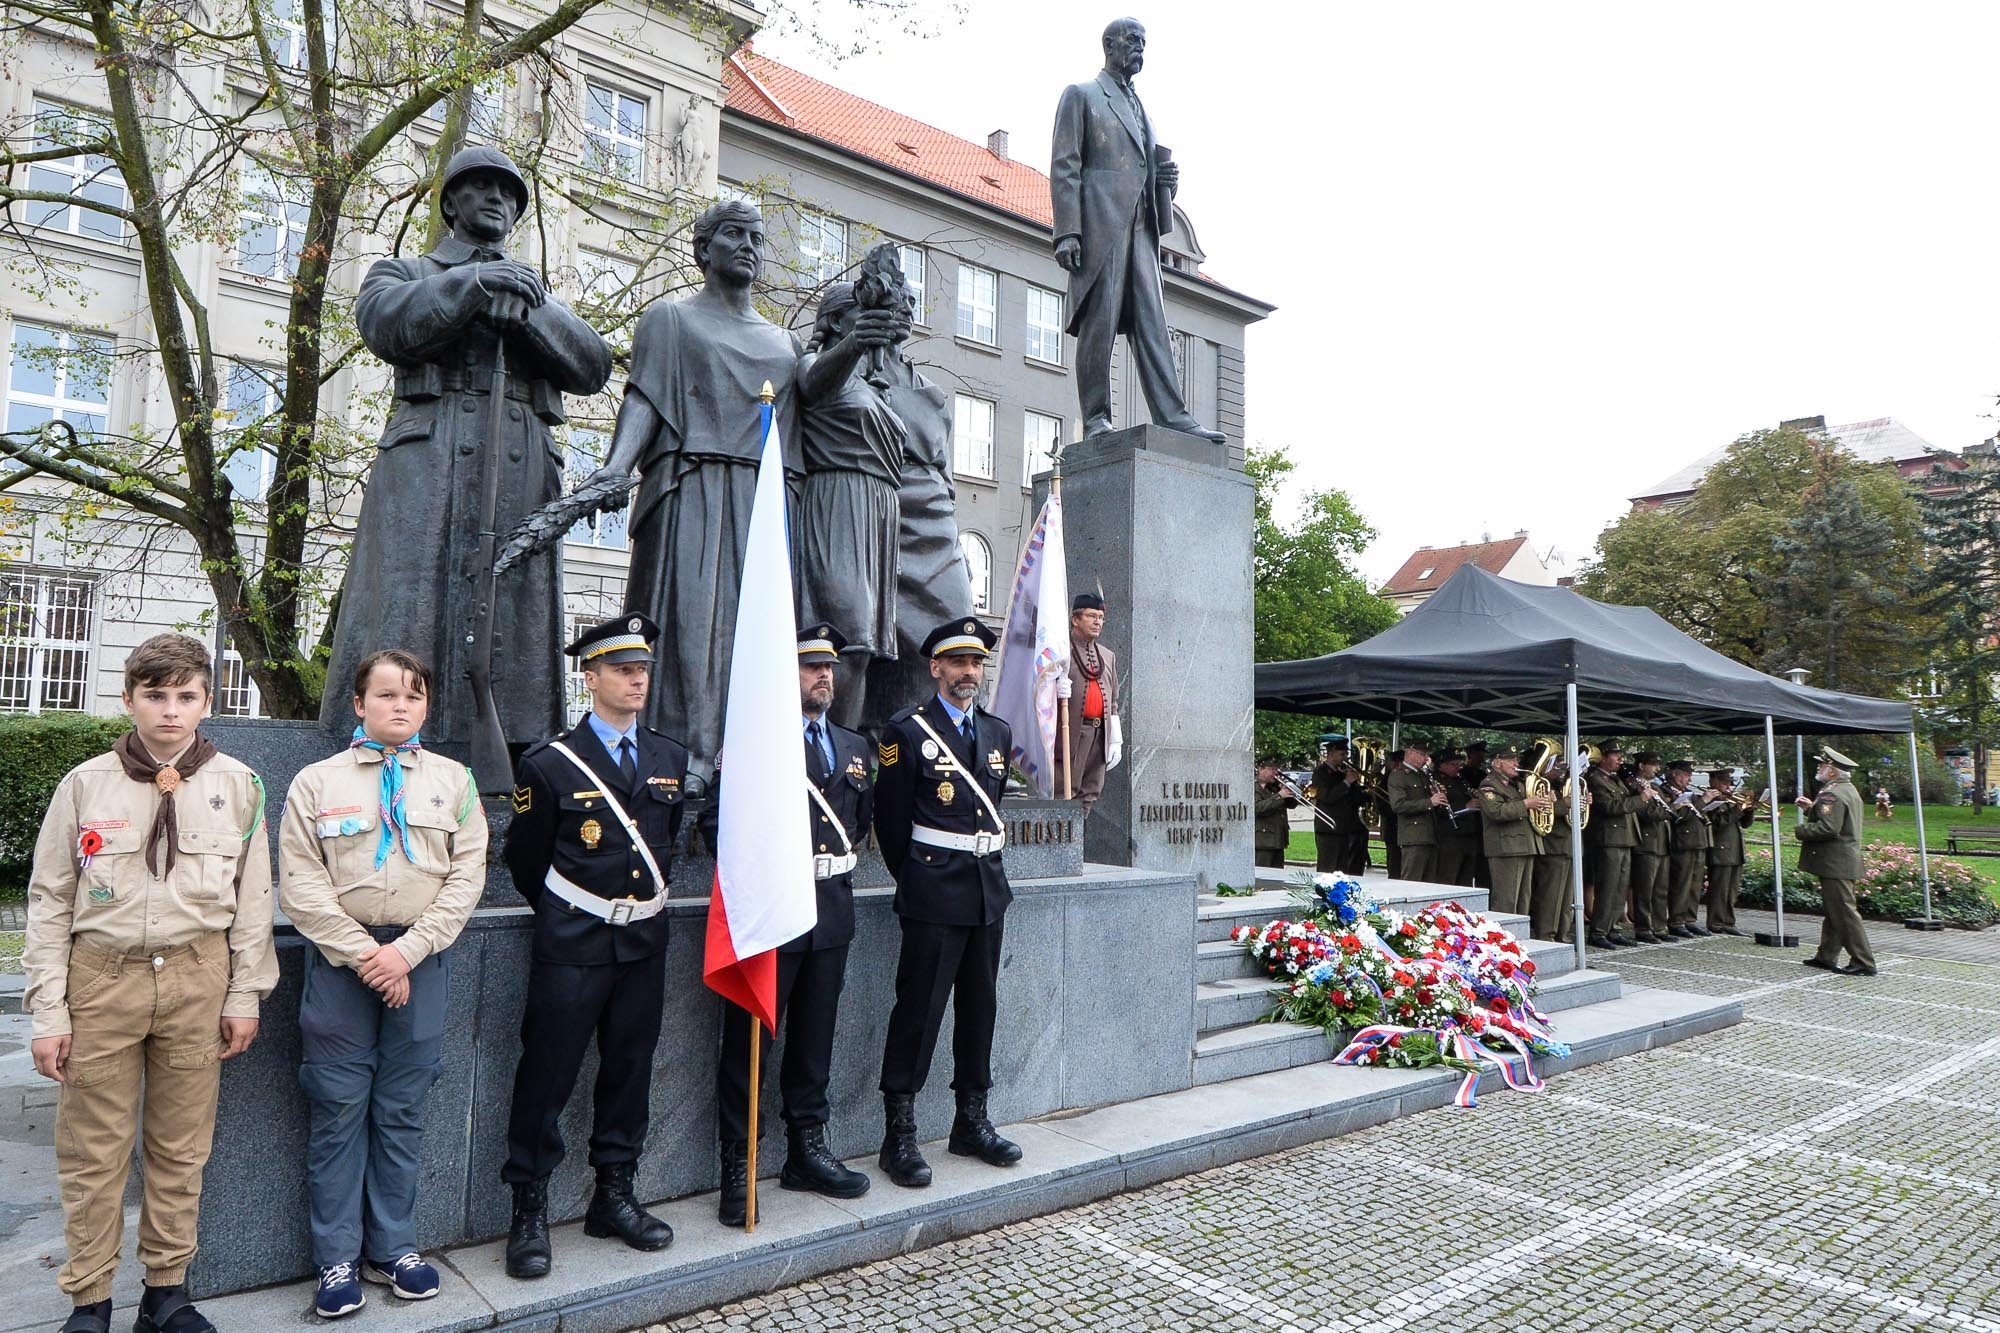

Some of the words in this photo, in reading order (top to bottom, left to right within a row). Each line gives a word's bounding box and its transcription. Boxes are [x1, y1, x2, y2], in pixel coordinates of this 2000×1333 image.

[1184, 782, 1230, 800] MASARYK
[1200, 804, 1211, 822] SE
[1216, 804, 1222, 821] O
